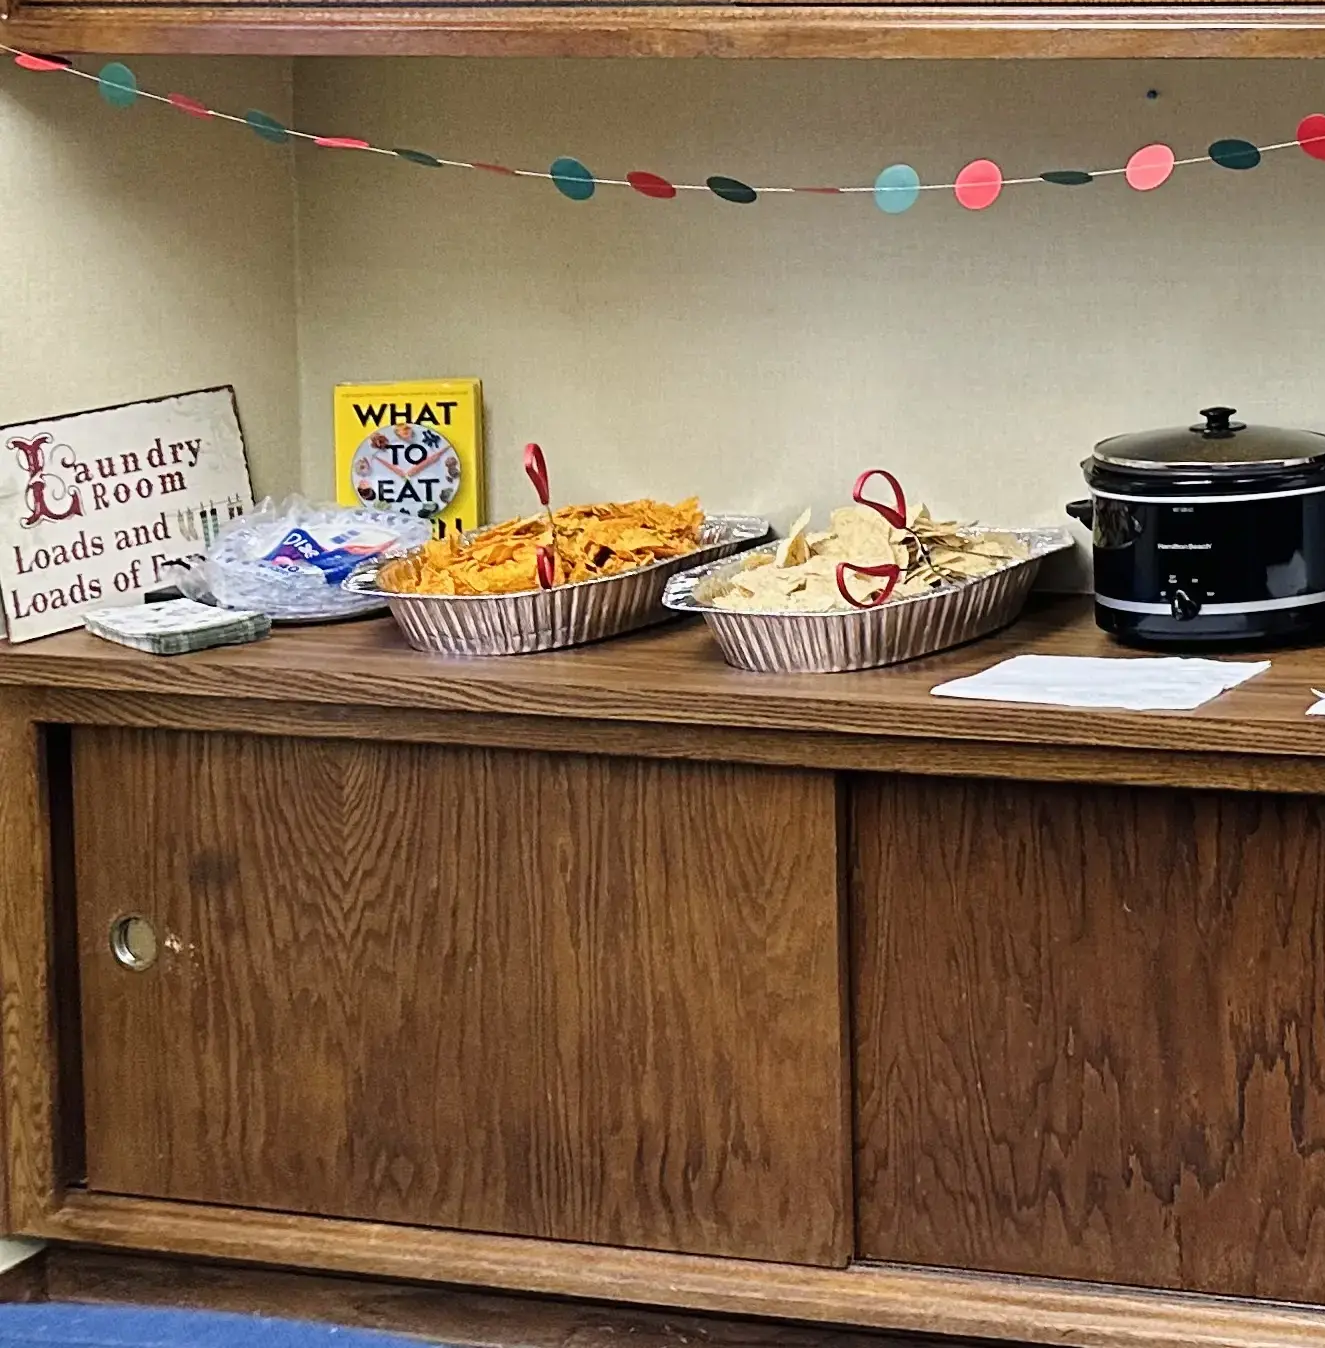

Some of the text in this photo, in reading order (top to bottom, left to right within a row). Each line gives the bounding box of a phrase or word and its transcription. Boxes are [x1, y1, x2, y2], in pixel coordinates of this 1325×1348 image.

[353, 401, 458, 427] WHAT
[386, 443, 428, 465] TO
[6, 432, 202, 529] Laundry
[377, 478, 440, 503] EAT
[13, 530, 104, 575] Loads
[114, 512, 172, 550] and
[11, 573, 102, 620] Loads
[113, 559, 142, 593] of
